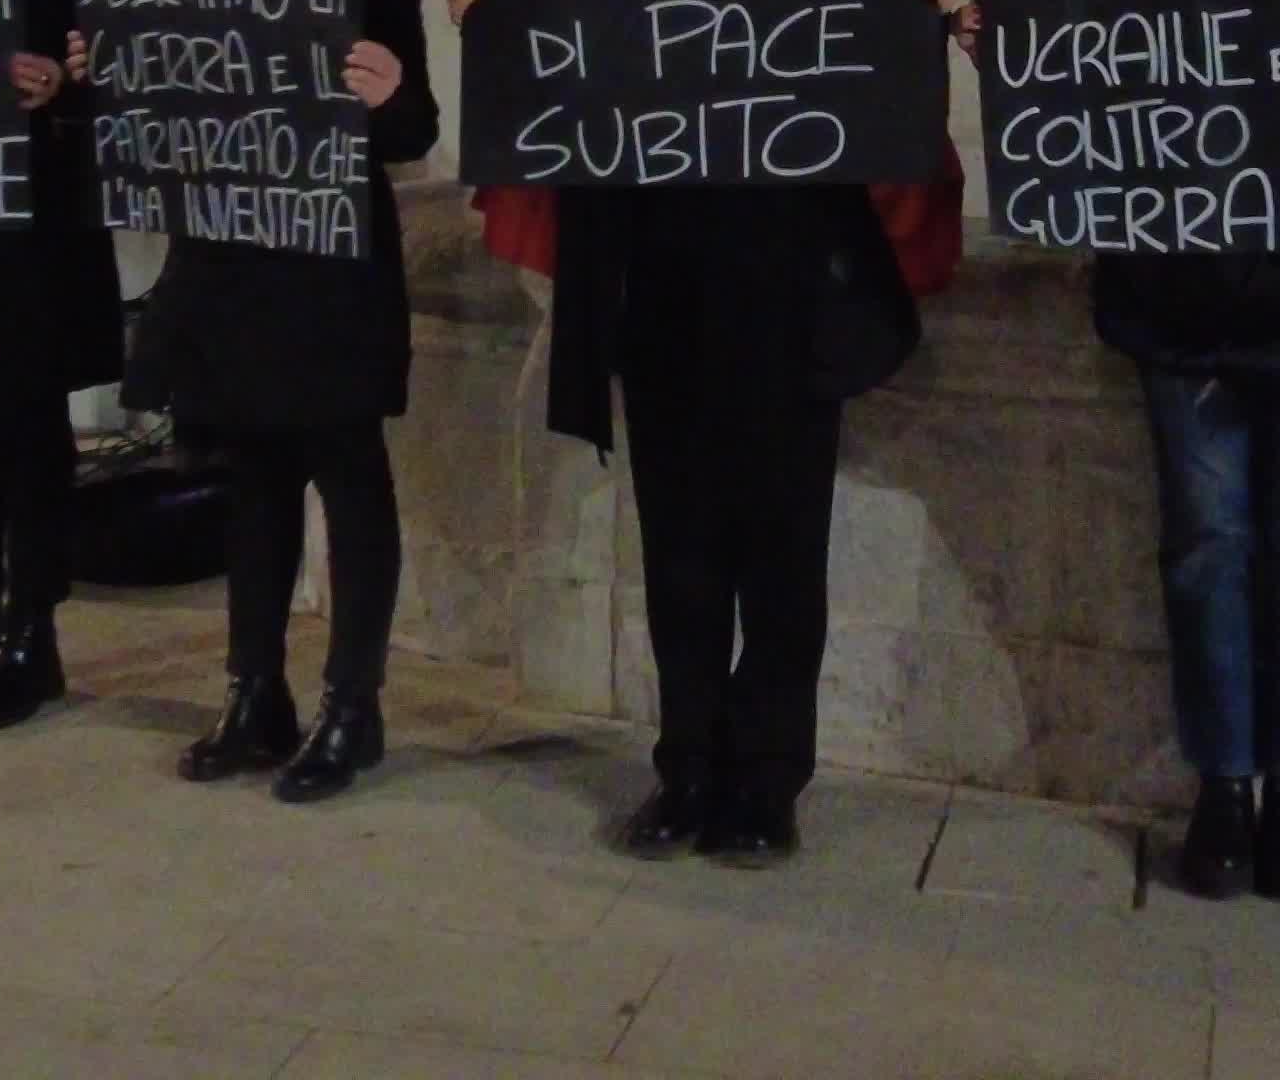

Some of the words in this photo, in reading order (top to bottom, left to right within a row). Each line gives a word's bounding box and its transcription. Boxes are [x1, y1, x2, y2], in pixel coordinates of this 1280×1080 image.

[89, 29, 254, 96] GUERRA
[268, 55, 298, 92] E
[311, 41, 360, 101] IL
[528, 20, 586, 79] DI
[644, 0, 874, 79] PACE
[998, 8, 1256, 88] UCRAINE
[94, 108, 297, 179] PATRIARCATO
[309, 126, 369, 184] CHE
[515, 94, 846, 184] SUBITO
[1001, 98, 1250, 170] CONTRO
[102, 177, 165, 232] L'HA
[184, 183, 359, 256] INVENTATA
[1007, 167, 1275, 254] GUERRA
